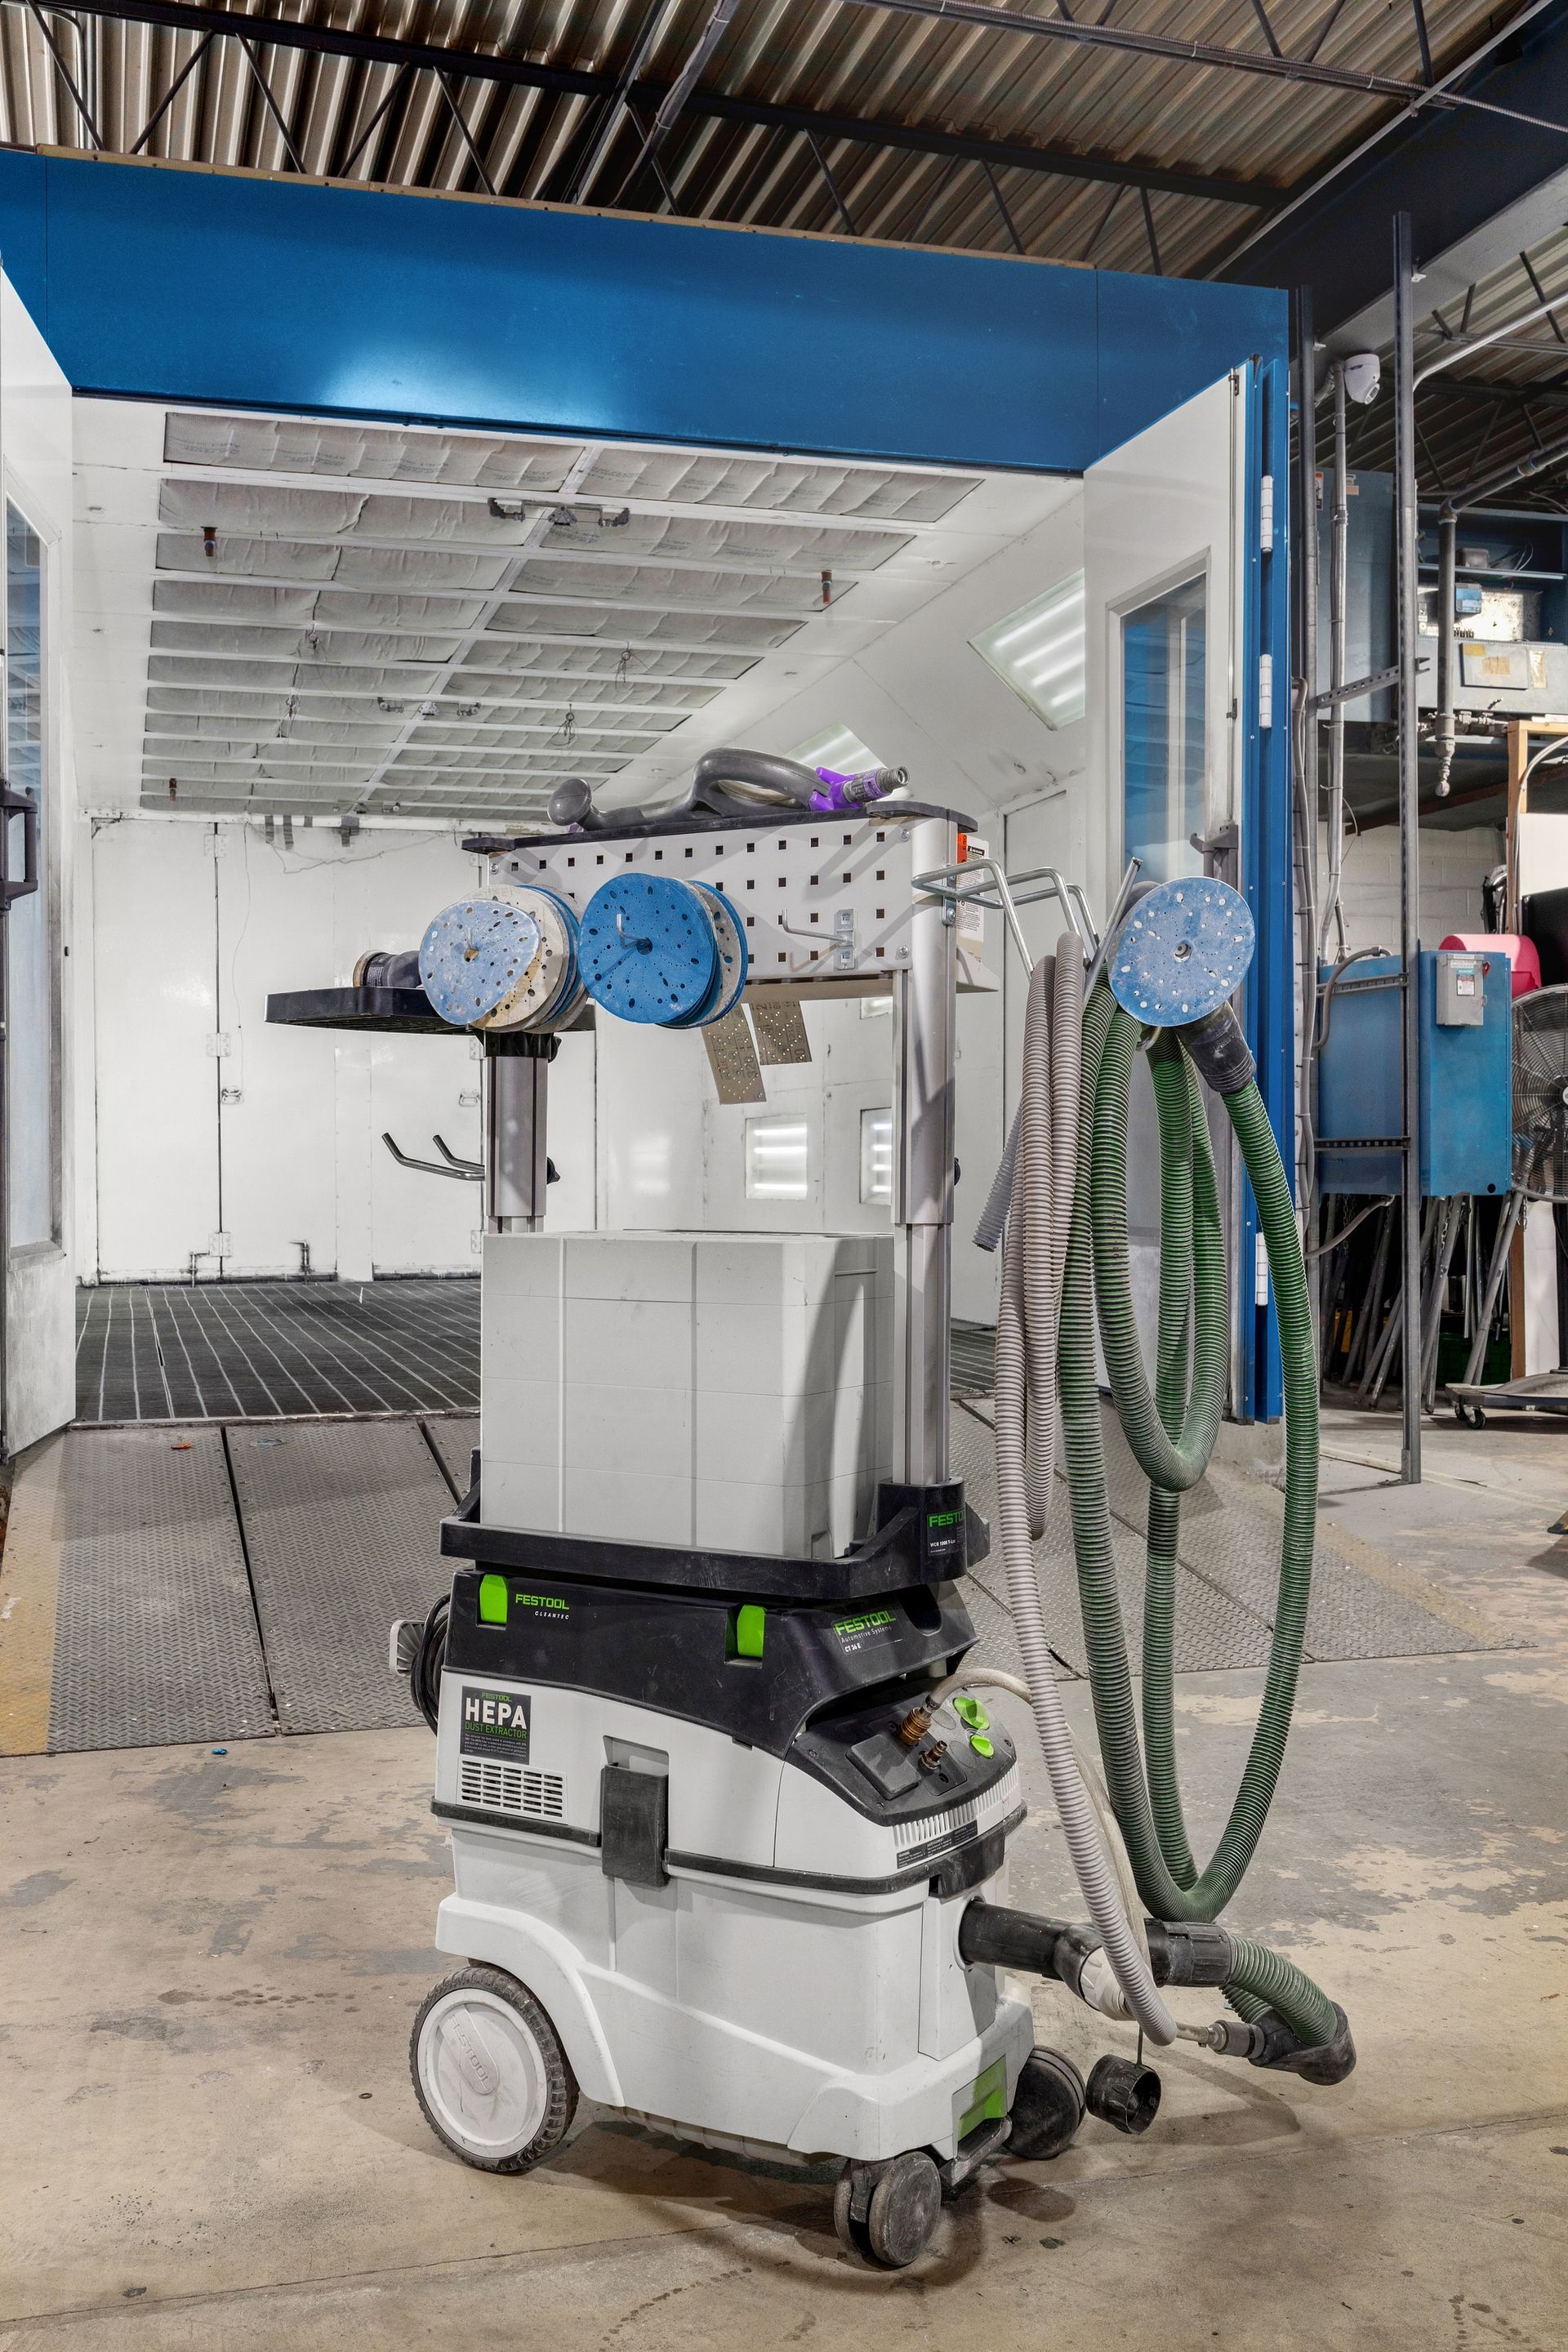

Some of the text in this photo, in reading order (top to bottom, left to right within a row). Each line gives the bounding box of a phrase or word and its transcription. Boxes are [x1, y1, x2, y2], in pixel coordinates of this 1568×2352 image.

[515, 1593, 570, 1610] FESTOOL
[534, 1610, 569, 1619] CLEANTEC
[835, 1610, 897, 1636] FESTOOL
[840, 1625, 893, 1644] Automotive Systems
[844, 1645, 852, 1653] CT
[482, 1692, 512, 1702] FESTOOL
[466, 1697, 528, 1730] HEPA
[465, 1721, 528, 1739] DUST EXTRACTOR
[451, 2013, 489, 2091] FESTOOL
